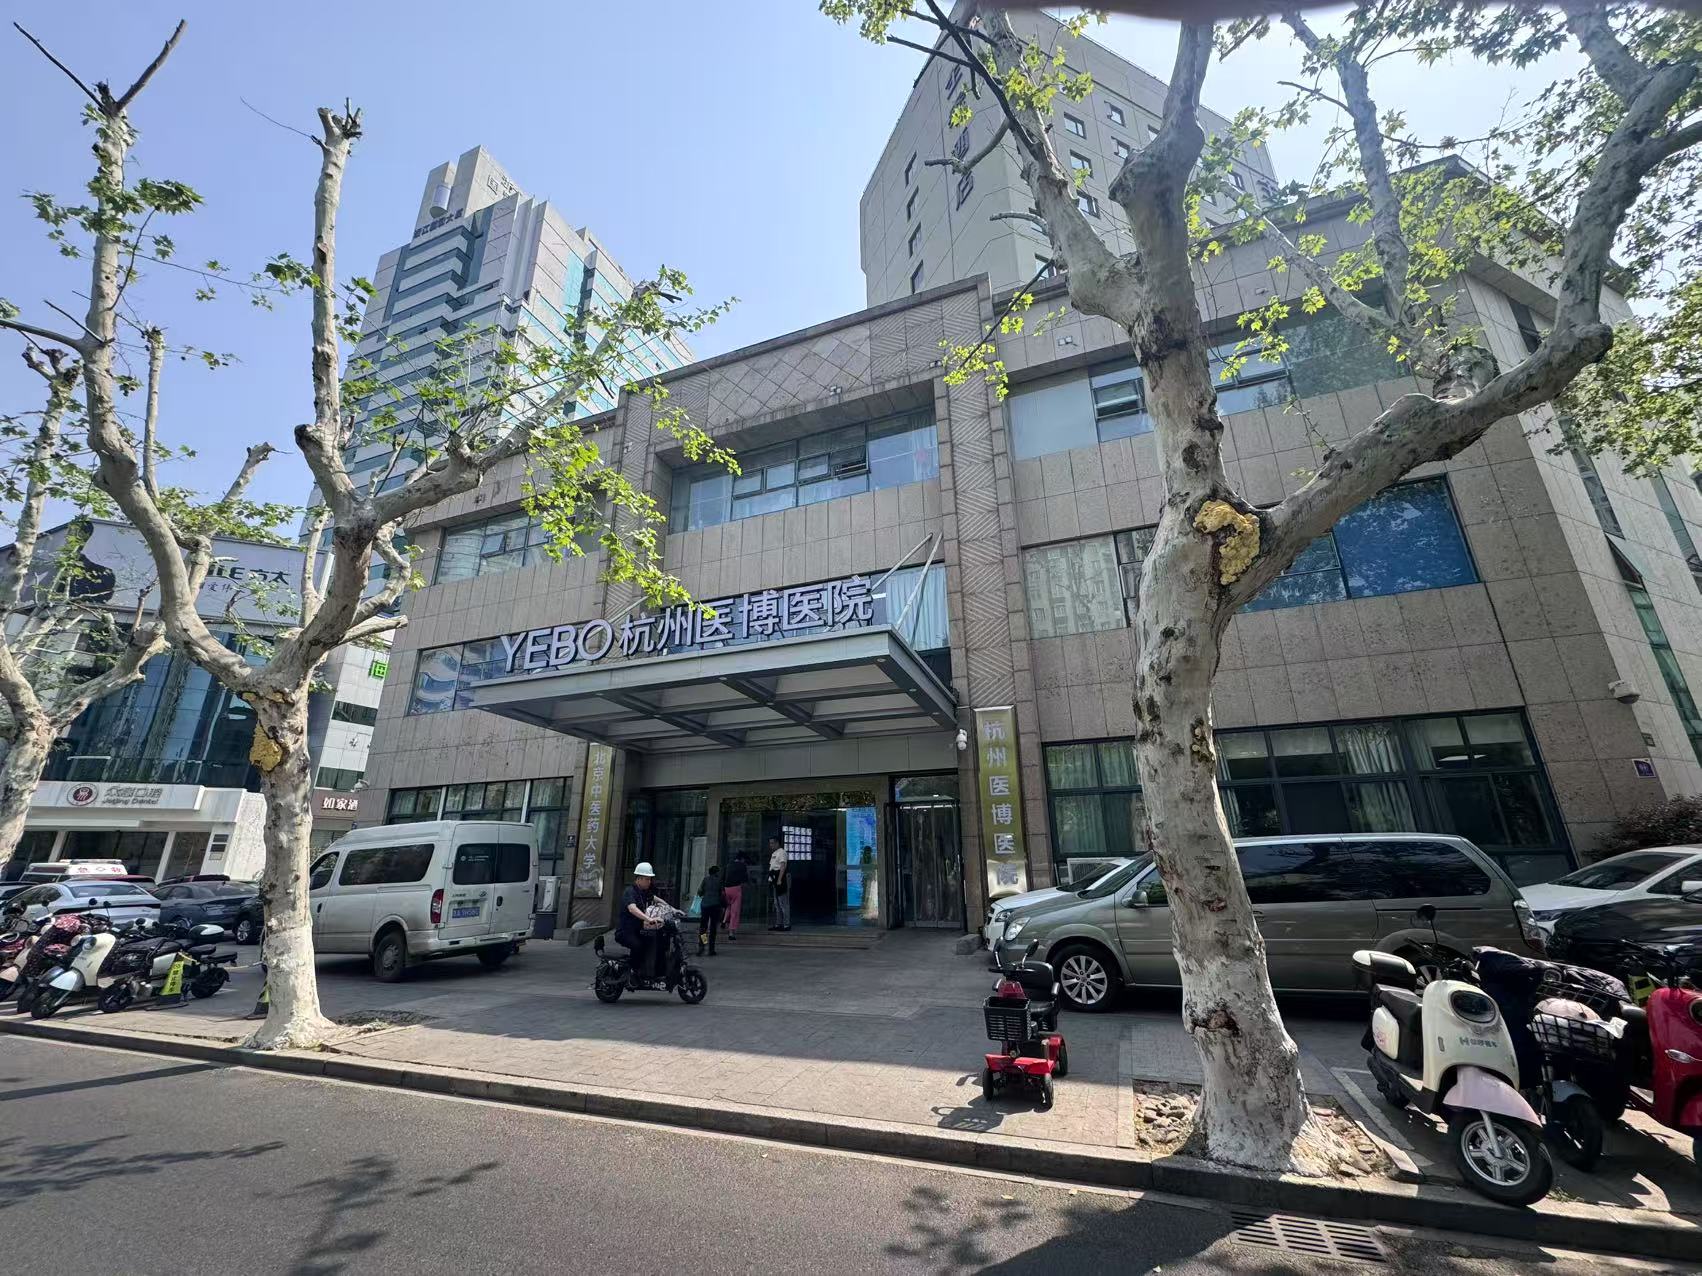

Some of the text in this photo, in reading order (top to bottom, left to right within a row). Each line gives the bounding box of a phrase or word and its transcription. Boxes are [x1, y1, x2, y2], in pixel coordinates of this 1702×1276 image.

[500, 577, 874, 673] YEBO 杭州医博医院
[322, 797, 359, 811] 如家酒
[583, 750, 606, 869] 北京中医药大学
[983, 720, 1019, 886] 杭州医博医院
